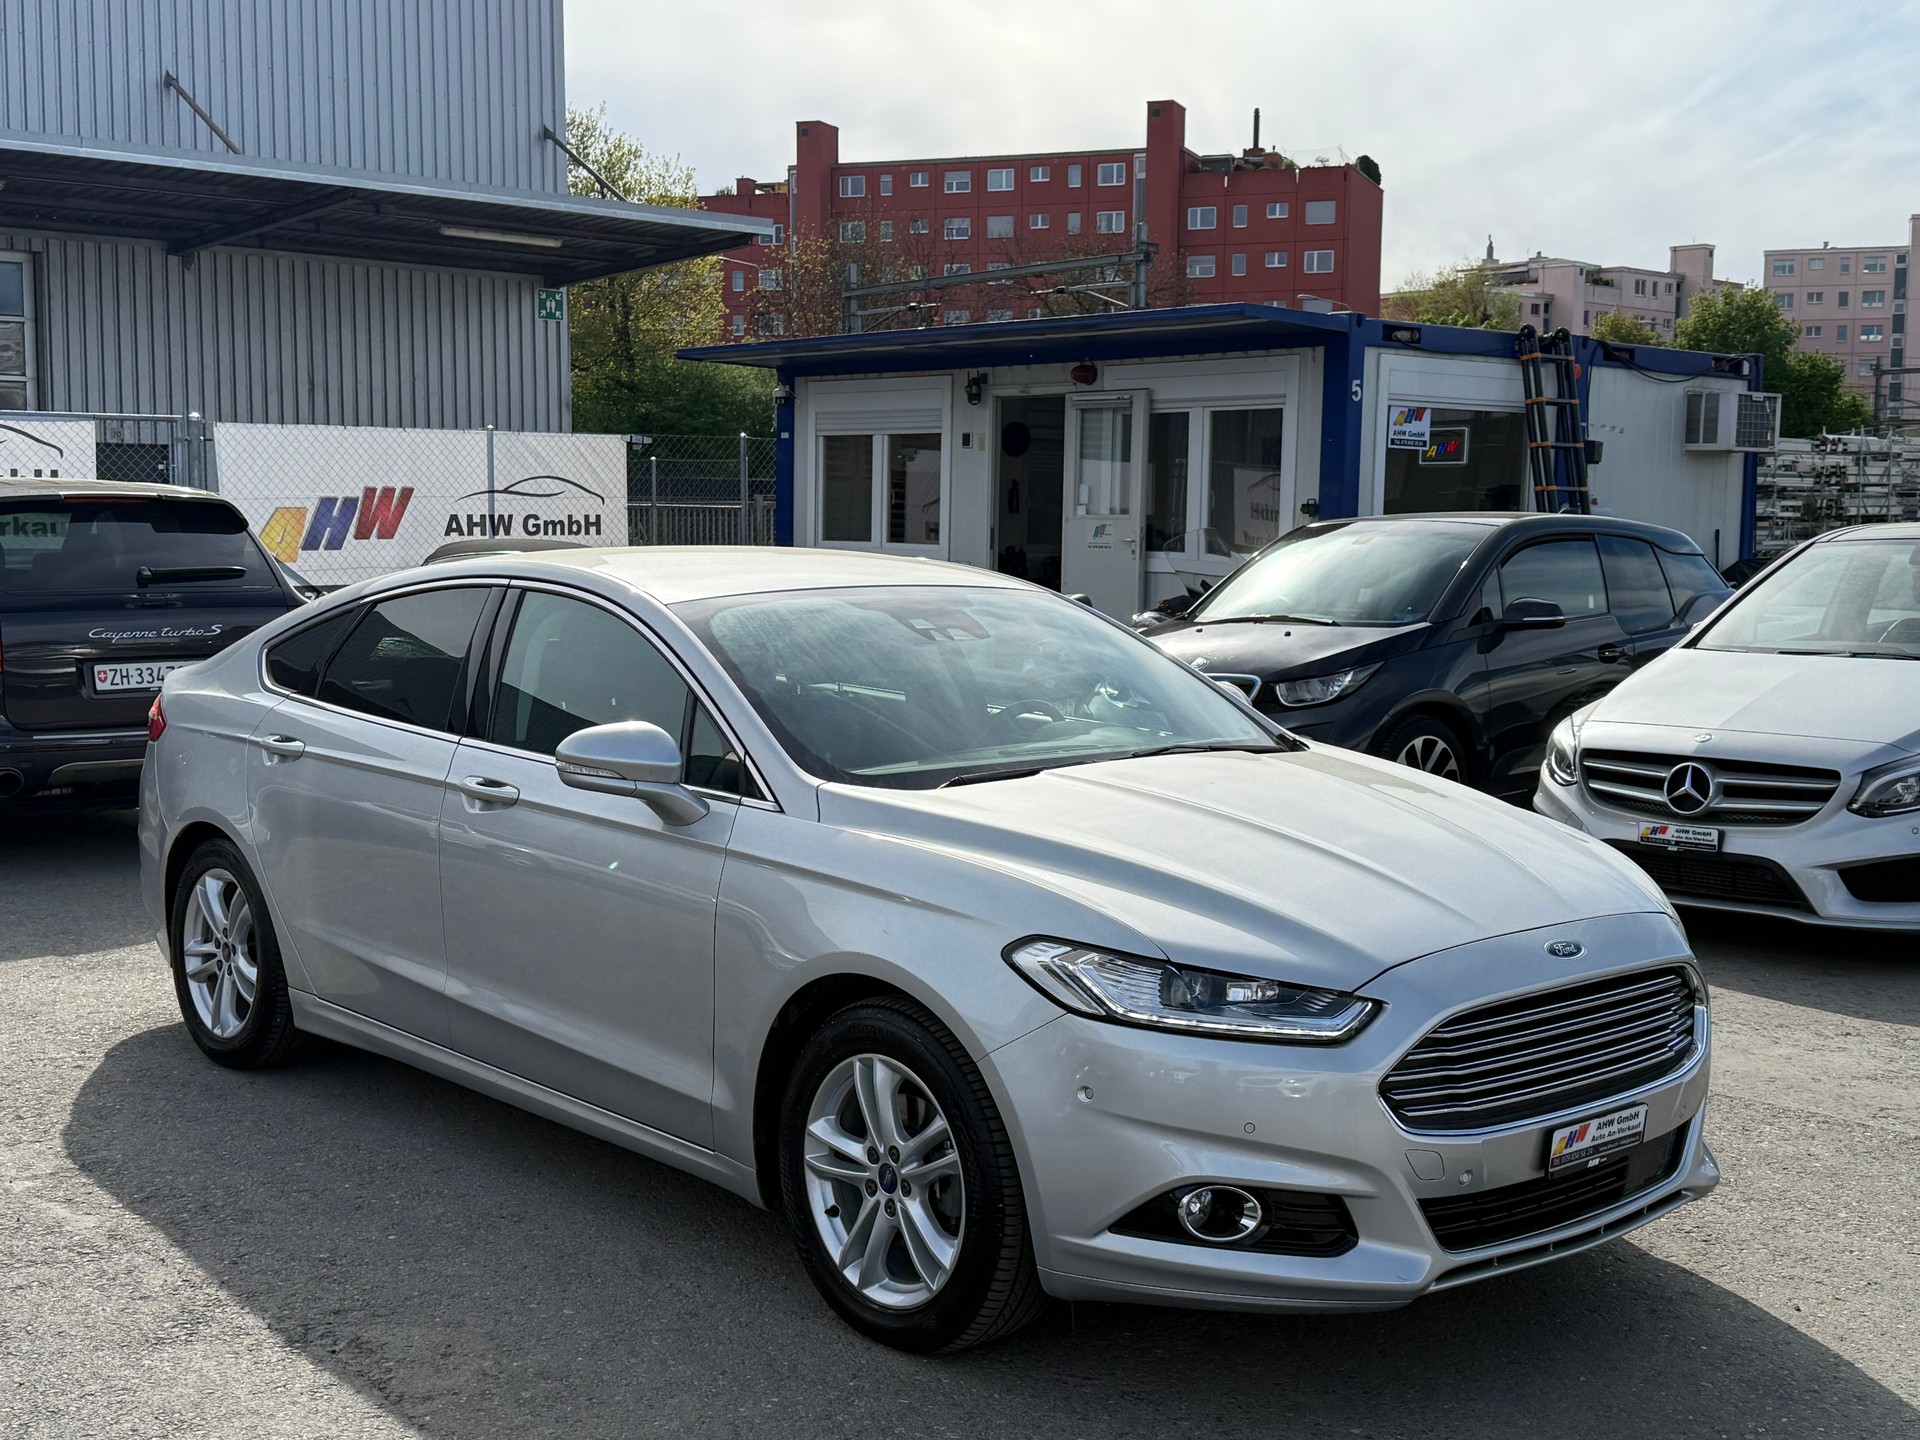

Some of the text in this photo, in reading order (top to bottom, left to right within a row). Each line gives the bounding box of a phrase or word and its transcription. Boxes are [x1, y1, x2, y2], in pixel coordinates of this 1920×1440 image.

[1351, 379, 1362, 402] 5
[1393, 429, 1426, 438] AHW GmbH
[258, 486, 415, 563] AHW
[444, 513, 602, 537] AHW GmbH
[88, 628, 157, 643] Cayenne
[1553, 942, 1577, 955] Ford
[1591, 1133, 1606, 1143] Auto
[1607, 1121, 1642, 1138] An-Verkauf
[1596, 1111, 1640, 1132] AHW GmbH
